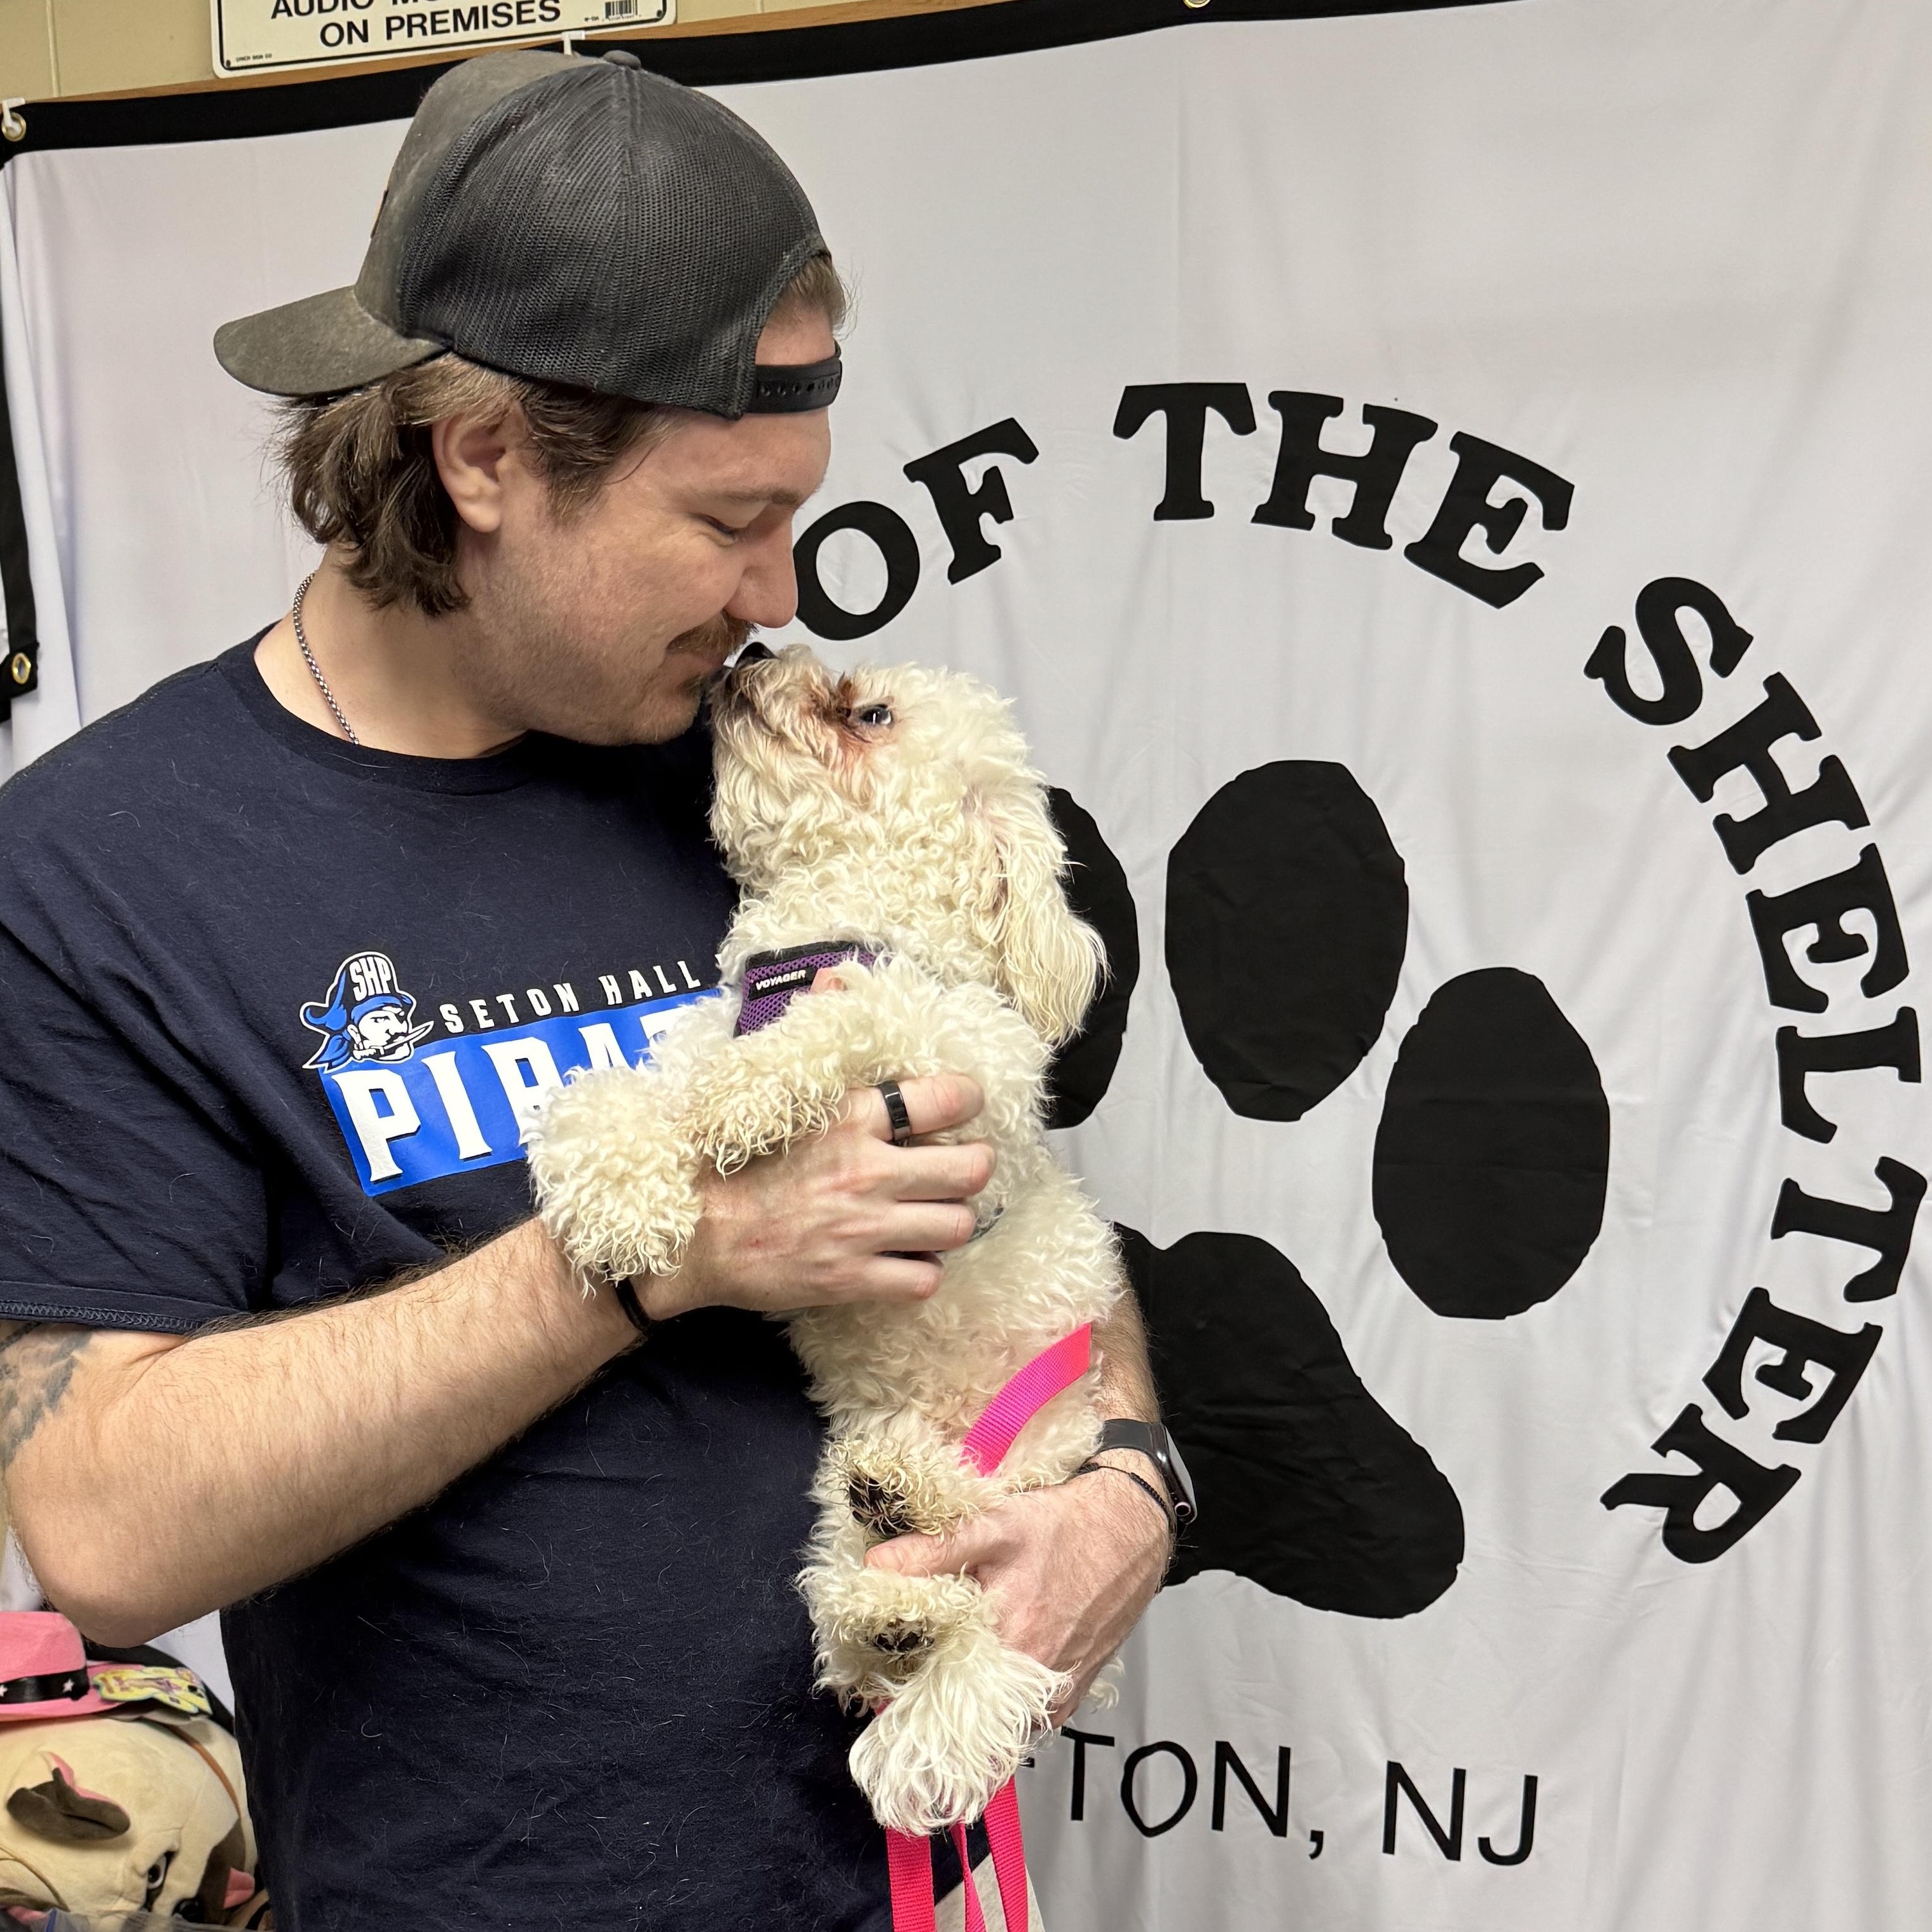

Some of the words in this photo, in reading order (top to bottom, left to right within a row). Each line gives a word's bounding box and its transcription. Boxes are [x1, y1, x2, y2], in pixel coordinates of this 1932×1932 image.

[320, 20, 369, 47] ON
[385, 0, 561, 41] PREMISES
[349, 956, 392, 1002] SHP
[439, 982, 580, 1033] SETON
[598, 961, 701, 1005] HALL
[755, 969, 806, 990] VOYAGER
[792, 417, 1039, 641] OF
[1113, 382, 1575, 609] THE
[1584, 577, 1928, 1564] SHELTER
[1019, 1724, 1324, 1860] TON,
[1383, 1760, 1538, 1866] NJ
